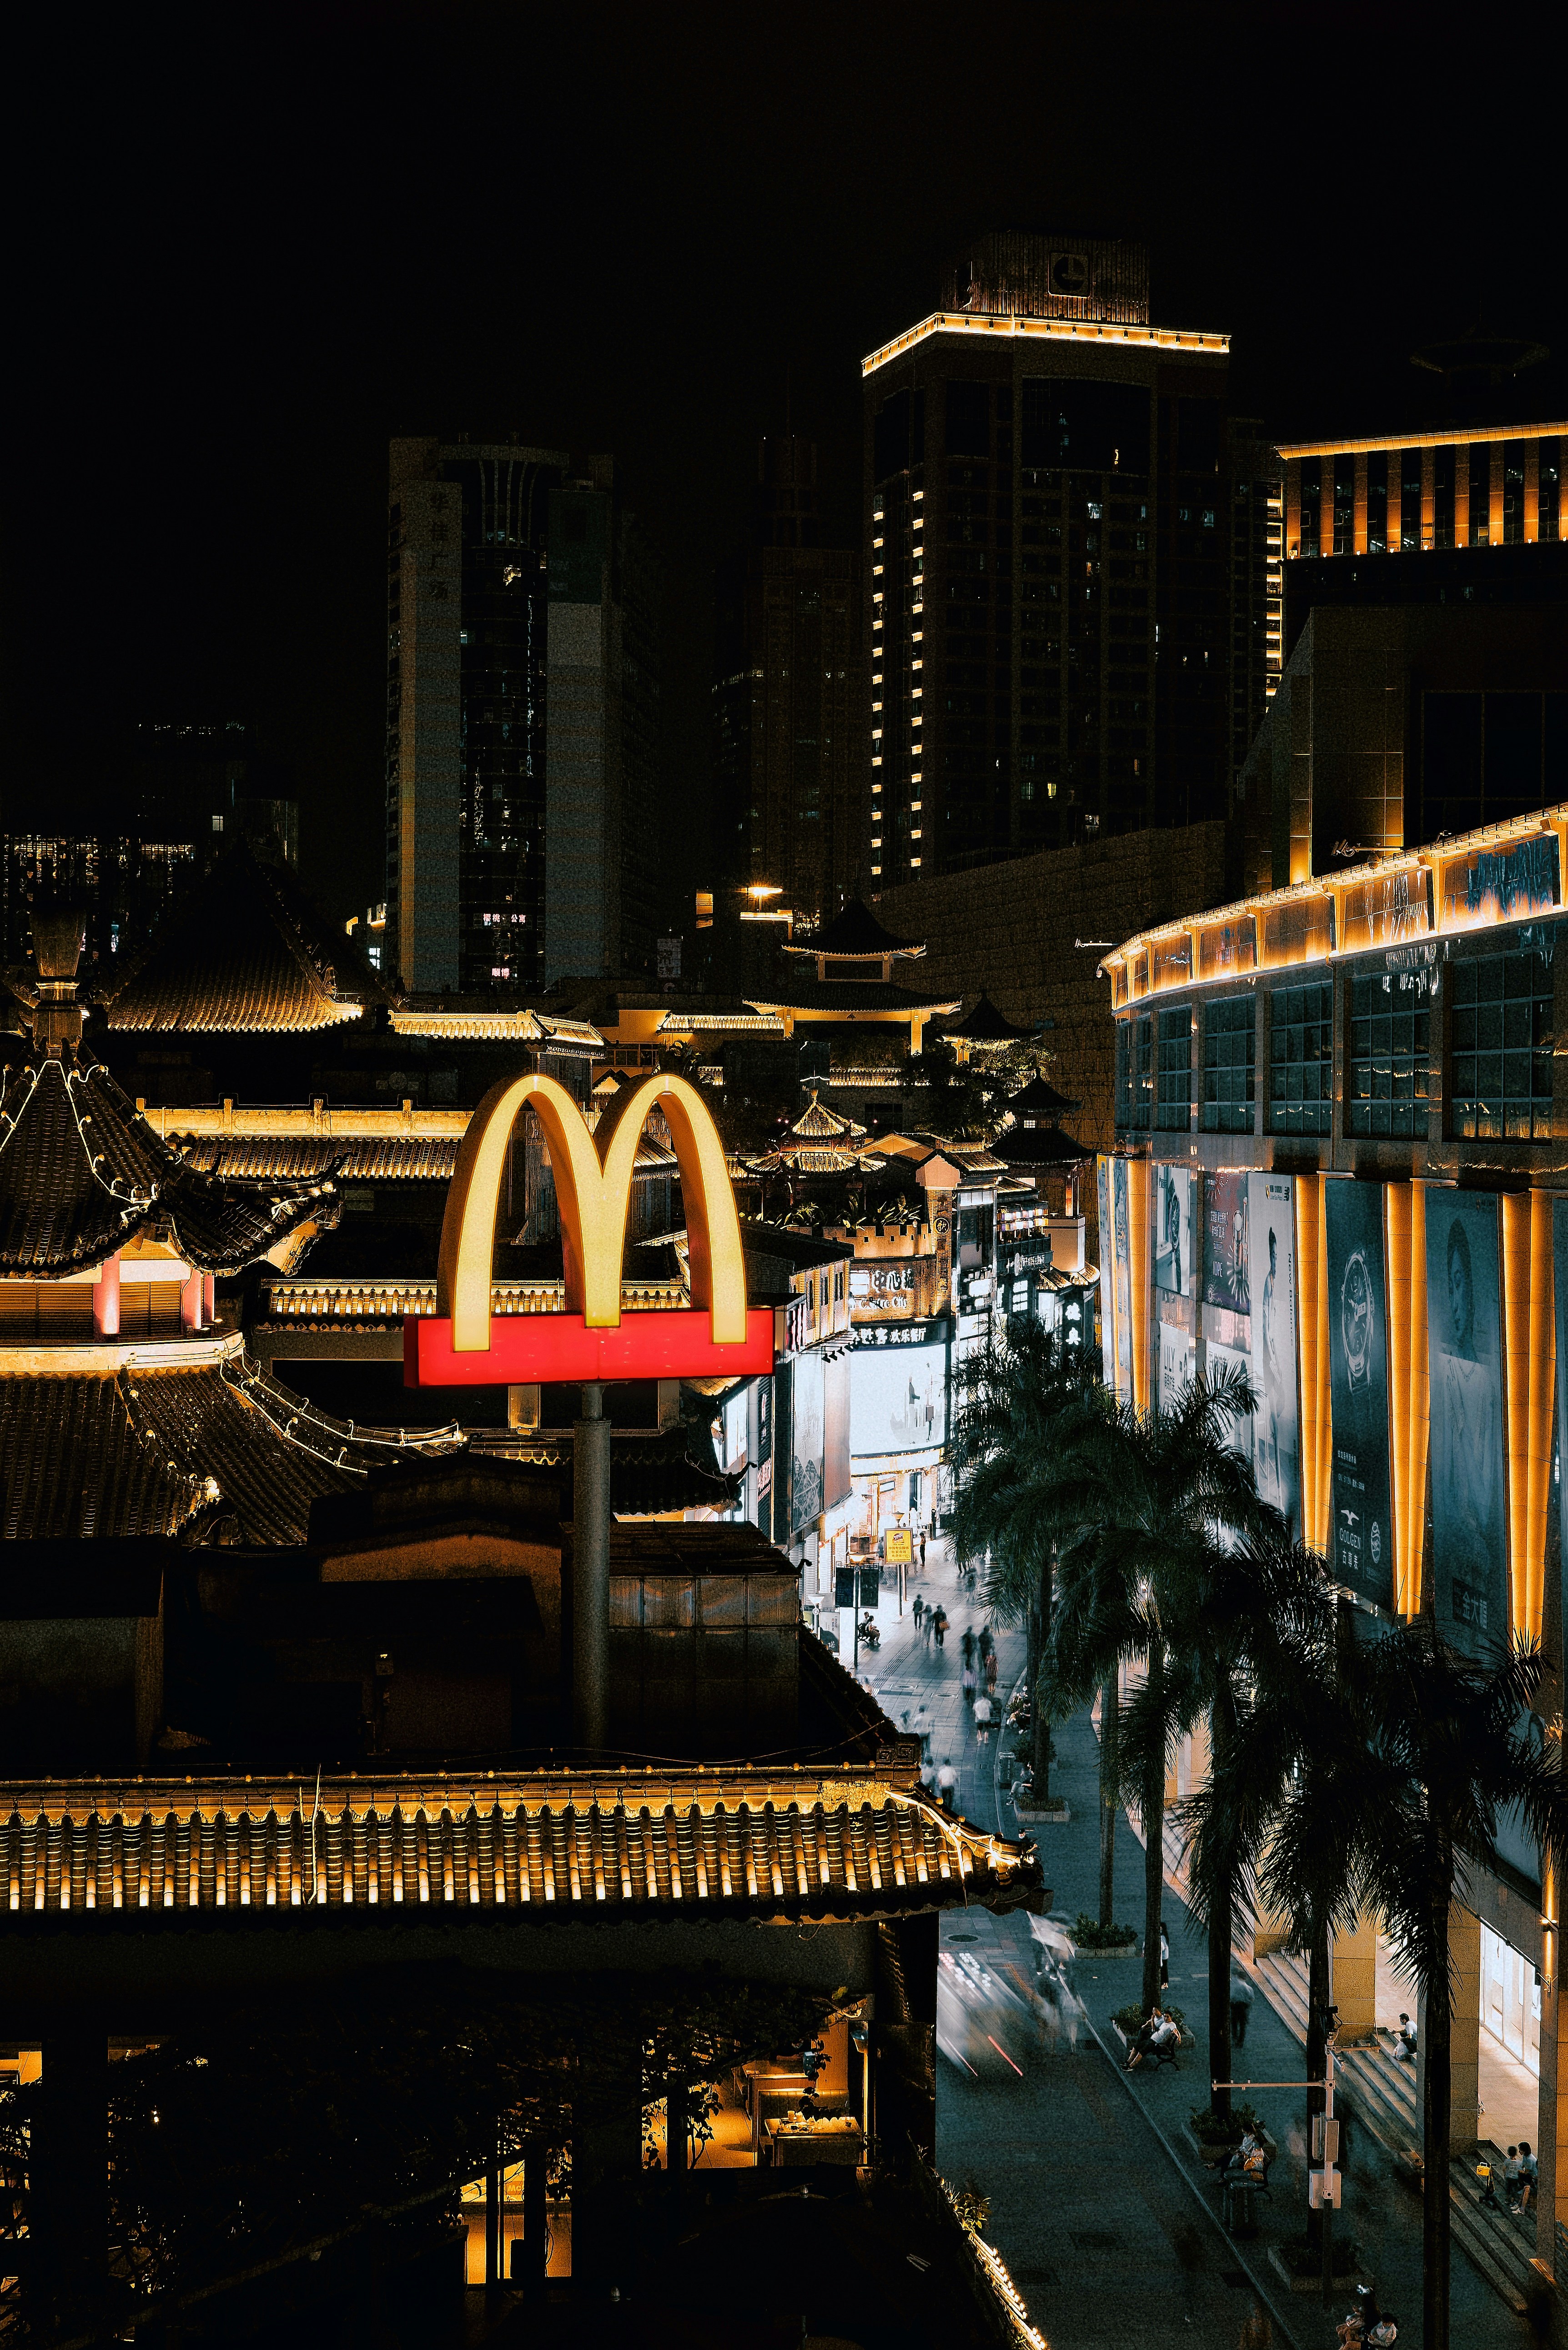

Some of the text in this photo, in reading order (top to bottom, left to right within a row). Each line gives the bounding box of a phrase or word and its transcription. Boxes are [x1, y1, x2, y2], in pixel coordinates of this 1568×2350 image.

[1213, 1261, 1223, 1277] IOPE
[890, 1326, 926, 1344] 欢乐餐厅
[1164, 1344, 1175, 1374] LILY
[1339, 1527, 1362, 1550] GOLGEN
[1342, 1548, 1358, 1570] 古尊表
[1462, 1591, 1487, 1630] 金大福
